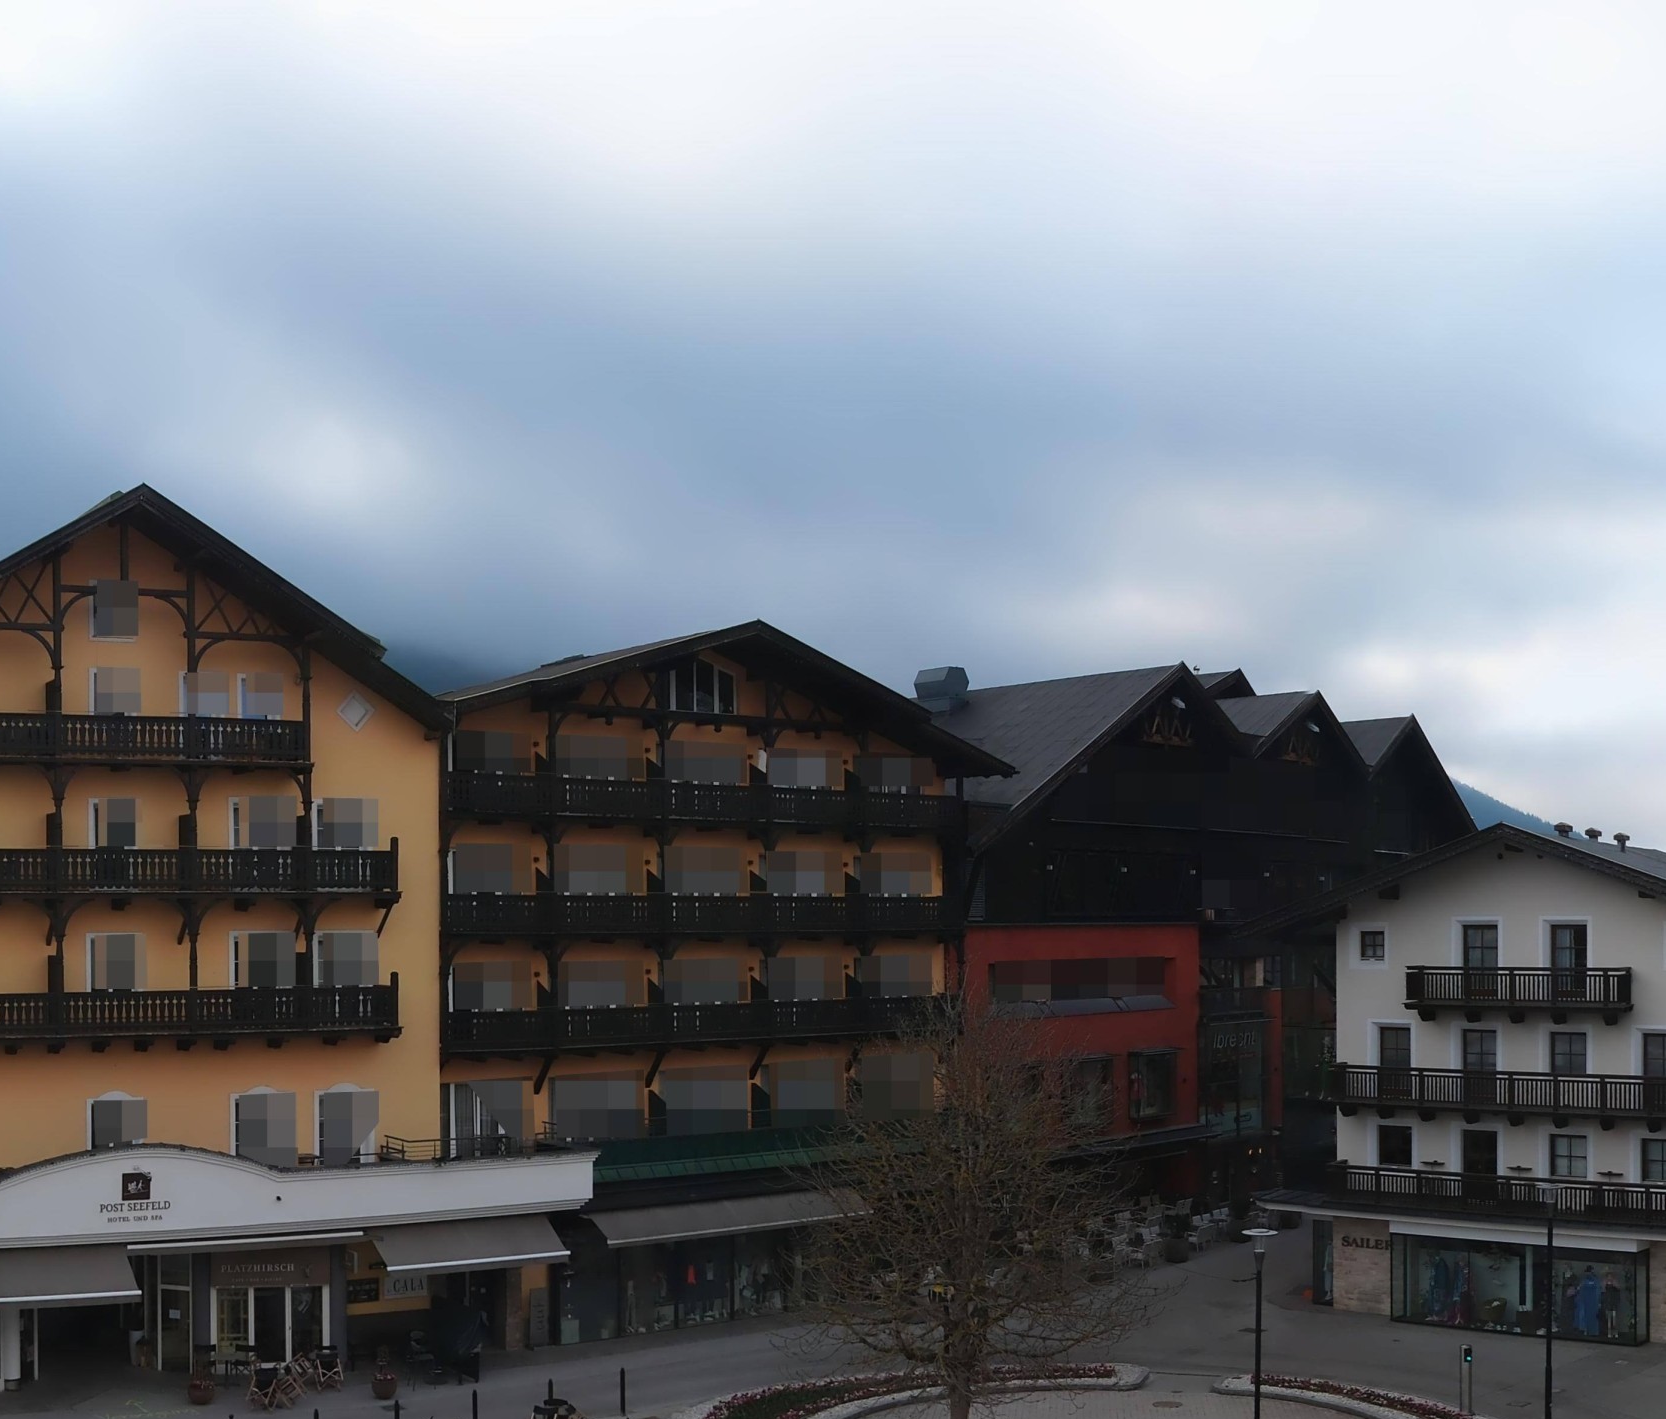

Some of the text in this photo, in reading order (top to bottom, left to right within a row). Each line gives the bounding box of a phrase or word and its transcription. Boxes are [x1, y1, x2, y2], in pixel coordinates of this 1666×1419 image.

[100, 1200, 171, 1213] POST SEEFELD
[221, 1263, 295, 1273] PLATZHIRSCH
